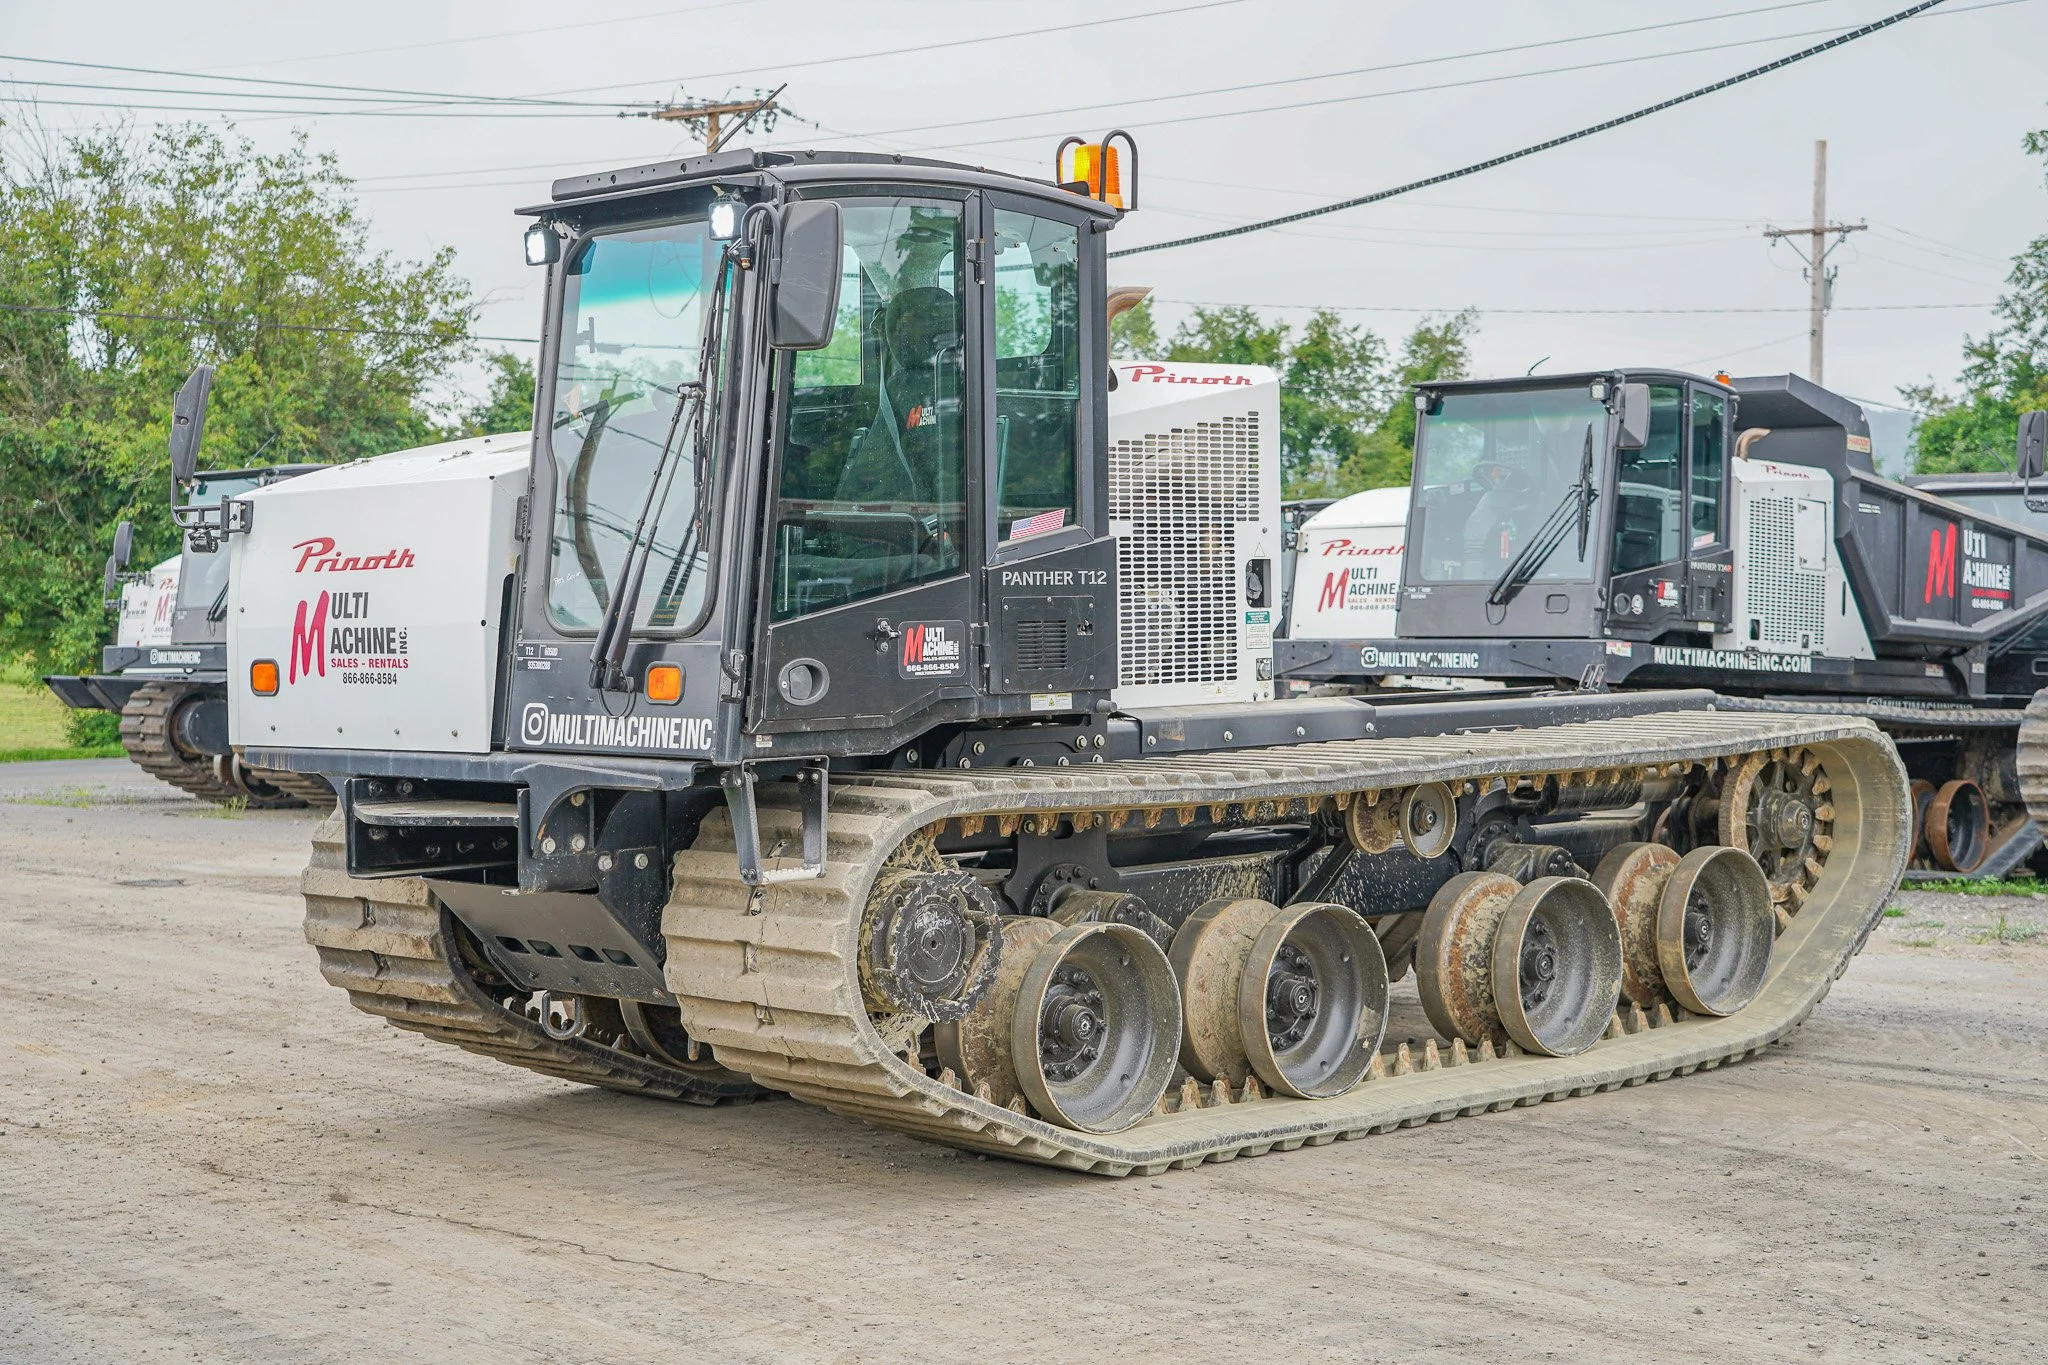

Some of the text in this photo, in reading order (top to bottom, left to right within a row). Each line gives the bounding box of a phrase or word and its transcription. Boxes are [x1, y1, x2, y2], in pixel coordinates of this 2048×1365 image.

[1120, 365, 1253, 386] Prinoth
[293, 537, 415, 573] Prinoth
[1002, 570, 1107, 586] PANTHER T12
[331, 658, 358, 669] SALES
[368, 658, 409, 669] RENTALS
[906, 663, 960, 672] 866-866-8584
[342, 673, 398, 685] 866-866-8584
[548, 713, 713, 751] MULTIMACHINEINC
